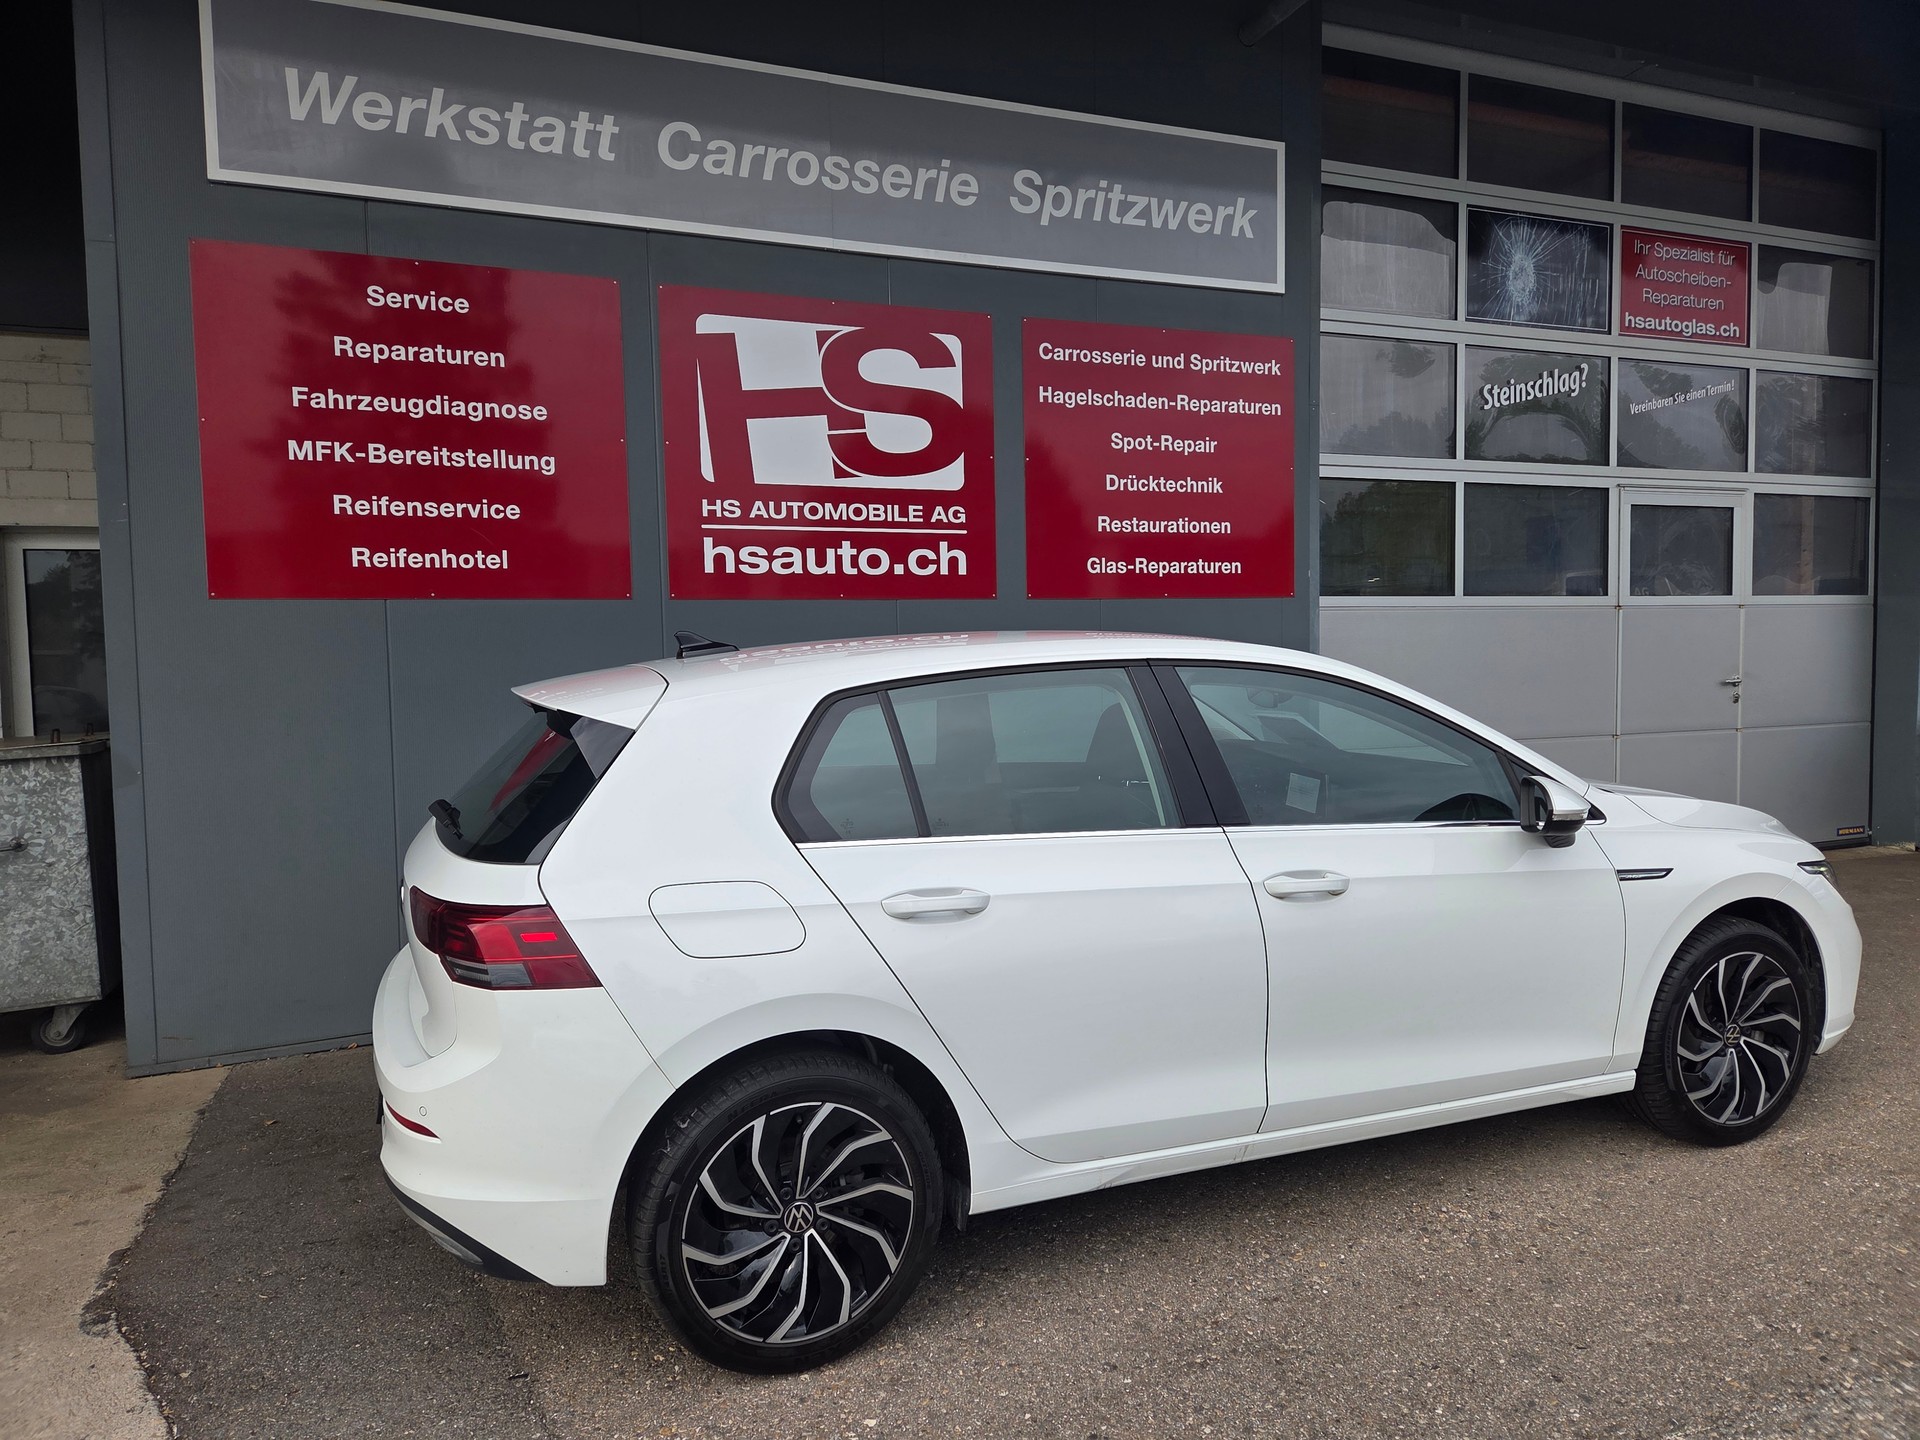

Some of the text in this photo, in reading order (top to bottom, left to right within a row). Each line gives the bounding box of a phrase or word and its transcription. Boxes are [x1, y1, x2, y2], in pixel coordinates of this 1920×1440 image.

[285, 67, 1258, 238] Werkstatt Carrosserie Spritzwerk
[1634, 240, 1736, 266] Ihr Spezialist für
[1635, 263, 1732, 288] Autoscheiben-
[367, 286, 469, 313] Service
[1642, 288, 1724, 311] Reparaturen
[1624, 311, 1740, 338] hsautoglas.ch
[334, 336, 505, 367] Reparaturen
[1039, 343, 1280, 375] Carrosserie und Spritzwerk
[1482, 363, 1589, 410] Steinschlag?
[1629, 379, 1736, 415] Vereinbaren Sie einen Termin!
[292, 387, 547, 421] Fahrzeugdiagnose
[696, 314, 965, 491] HS
[1040, 386, 1281, 415] Hagelschaden-Reparaturen
[288, 440, 555, 475] MFK-Bereitstellung
[1111, 433, 1217, 455] Spot-Repair
[1106, 475, 1223, 493] Drücktechnik
[334, 495, 520, 519] Reifenservice
[702, 499, 965, 523] HS AUTOMOBILE AG
[1098, 516, 1230, 533] Restaurationen
[352, 548, 507, 569] Reifenhotel
[704, 537, 966, 575] hsauto.ch
[1087, 558, 1241, 577] Glas-Reparaturen
